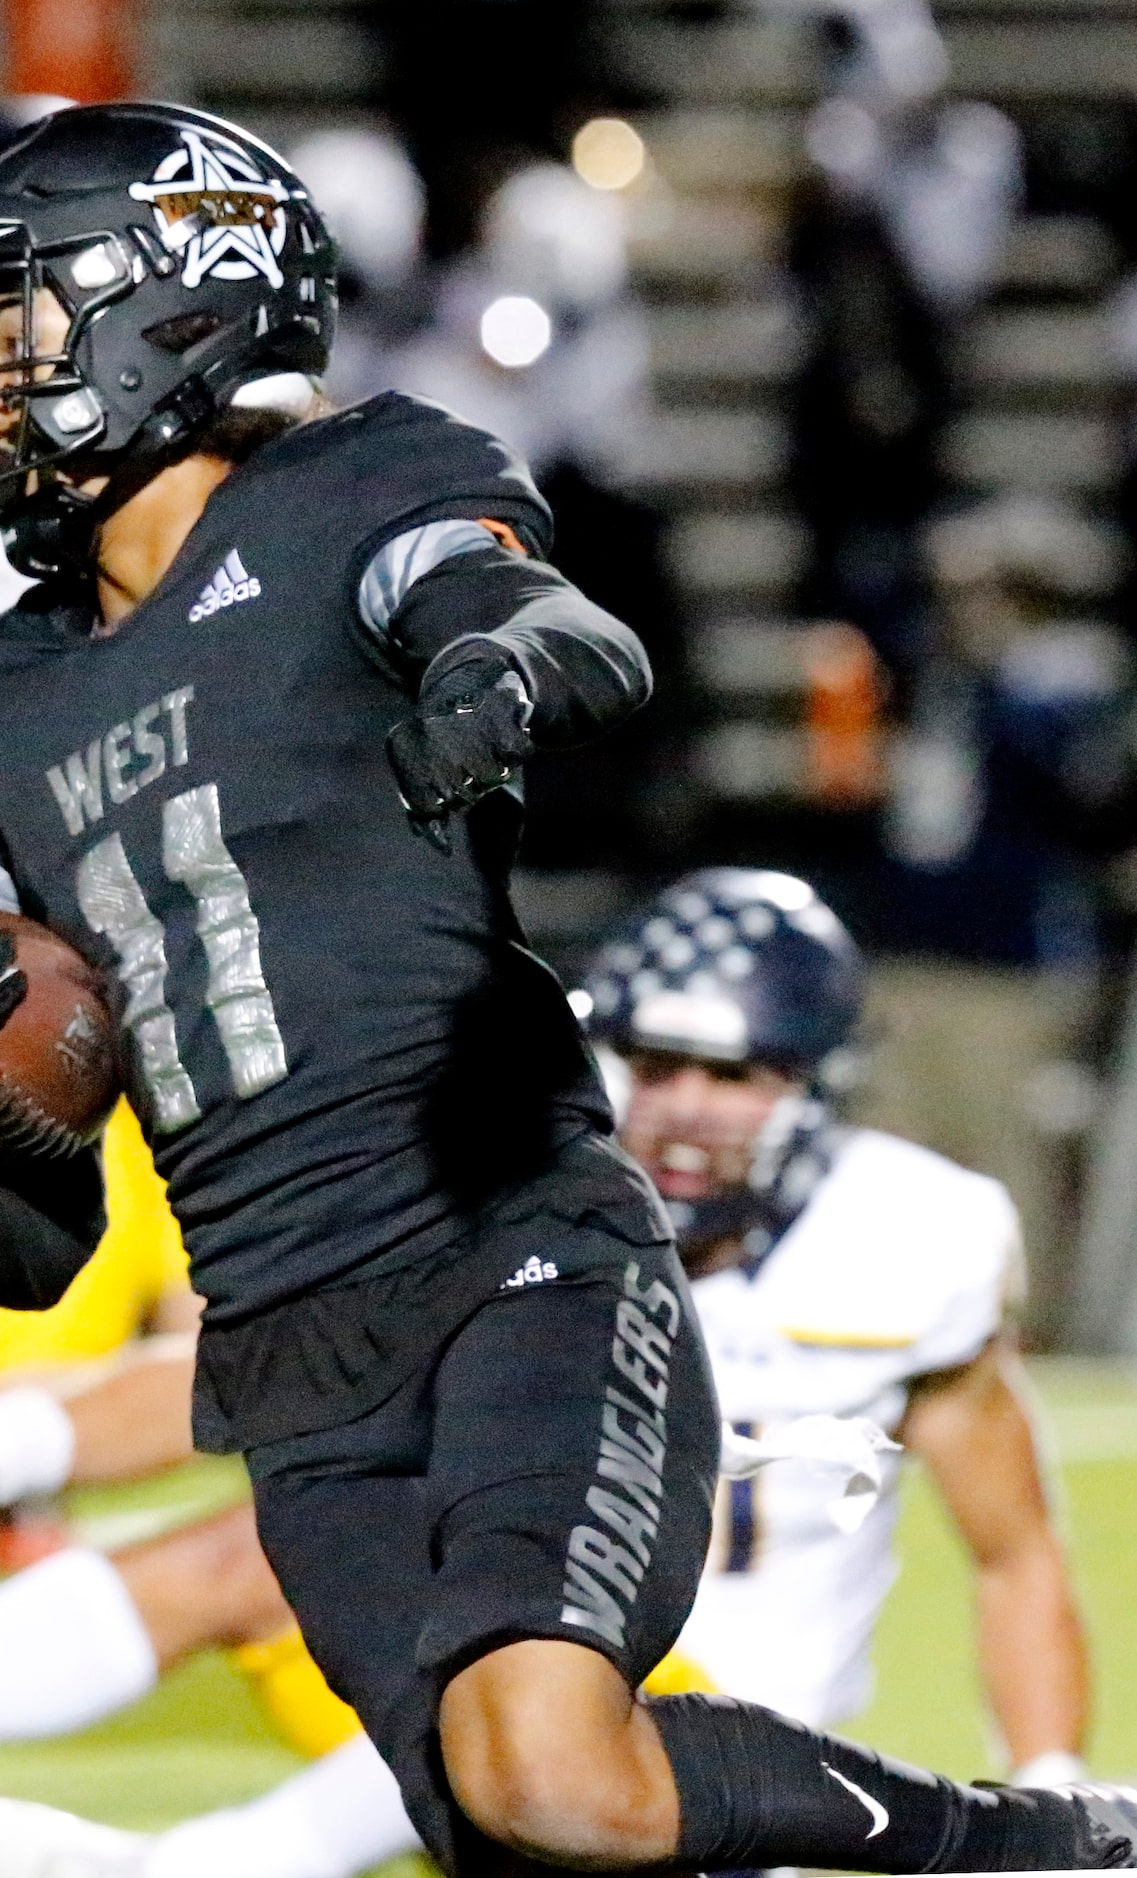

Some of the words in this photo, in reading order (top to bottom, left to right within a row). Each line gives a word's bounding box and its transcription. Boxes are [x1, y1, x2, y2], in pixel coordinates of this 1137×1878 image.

[189, 577, 261, 622] adidas
[46, 685, 194, 836] WEST
[76, 783, 289, 1134] 11
[560, 1262, 680, 1648] WRANGLERS
